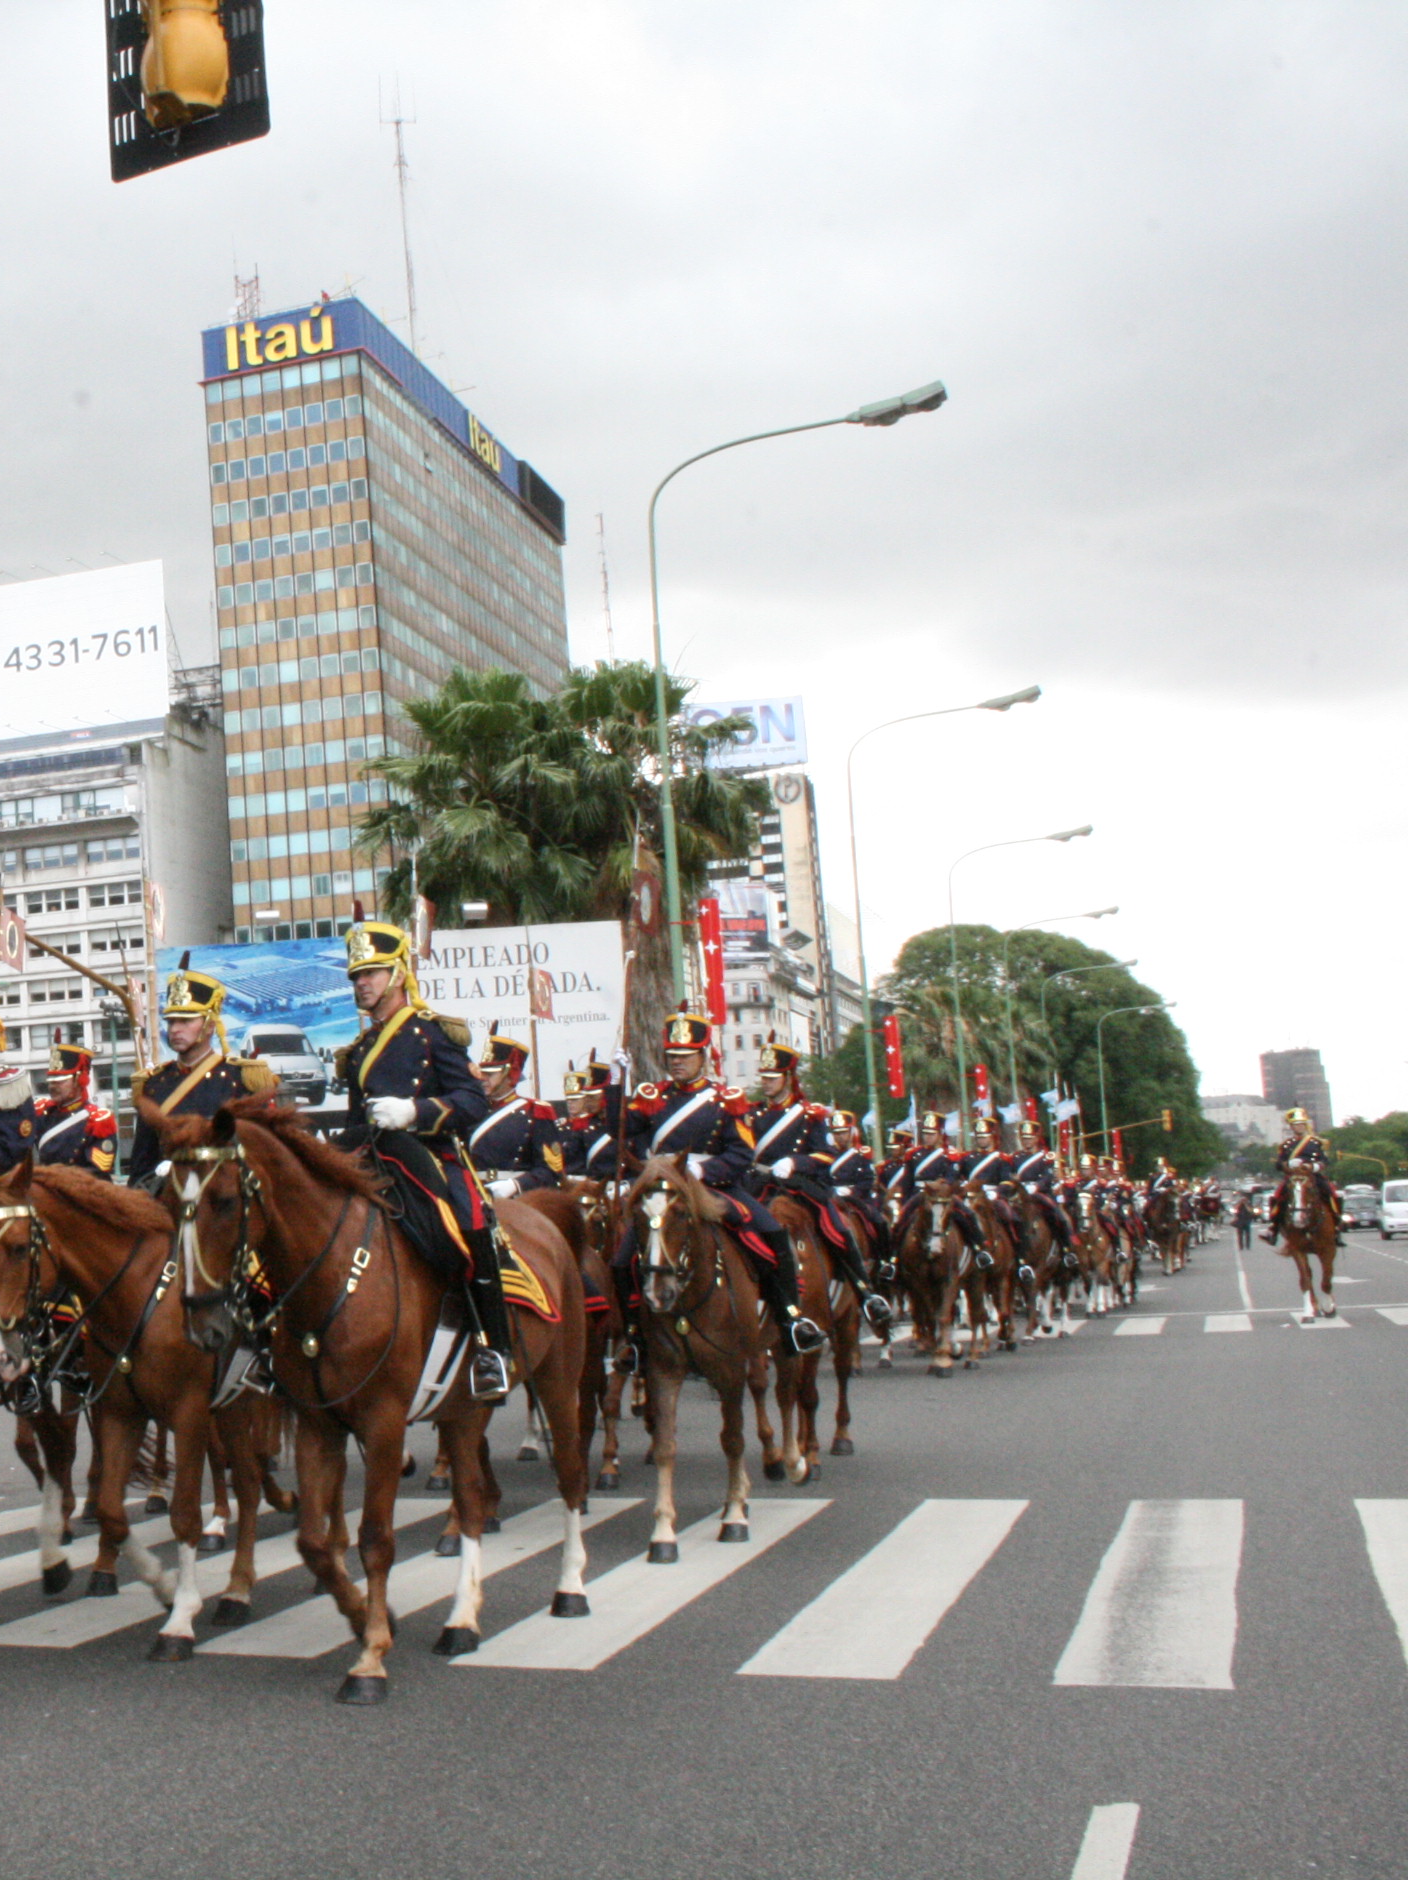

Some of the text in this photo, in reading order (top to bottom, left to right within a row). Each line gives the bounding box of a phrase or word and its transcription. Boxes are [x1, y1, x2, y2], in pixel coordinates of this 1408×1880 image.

[225, 306, 334, 371] Itaú
[468, 410, 501, 474] Itaú
[3, 624, 159, 672] 4331-7611
[417, 941, 549, 971] EMPLEADO
[417, 968, 601, 1000] DE LA DÉADA.
[479, 1015, 527, 1030] Spinter
